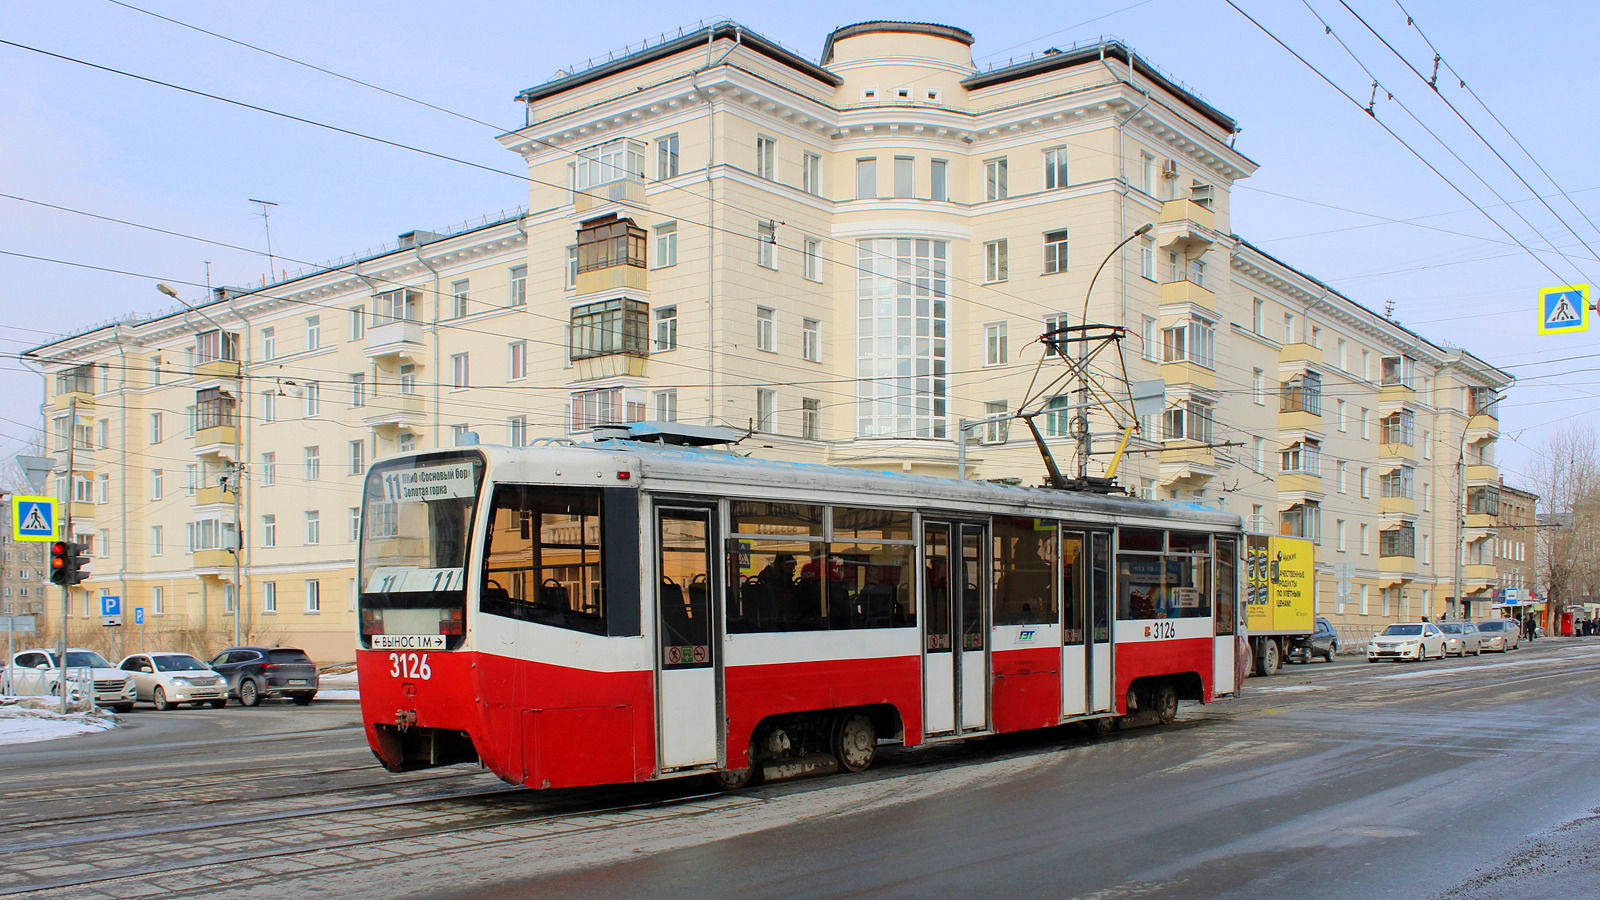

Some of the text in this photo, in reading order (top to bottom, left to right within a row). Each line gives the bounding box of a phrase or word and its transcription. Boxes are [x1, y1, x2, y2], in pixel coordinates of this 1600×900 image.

[385, 473, 402, 500] 11
[403, 485, 448, 498] Золотая горка
[432, 570, 454, 592] 11
[1279, 570, 1305, 579] АЧЕСТВЕННЫЕ
[380, 575, 398, 593] 11
[105, 599, 117, 613] P
[1153, 621, 1176, 639] 3126
[382, 636, 414, 648] ВЫНОС
[389, 652, 432, 681] 3126
